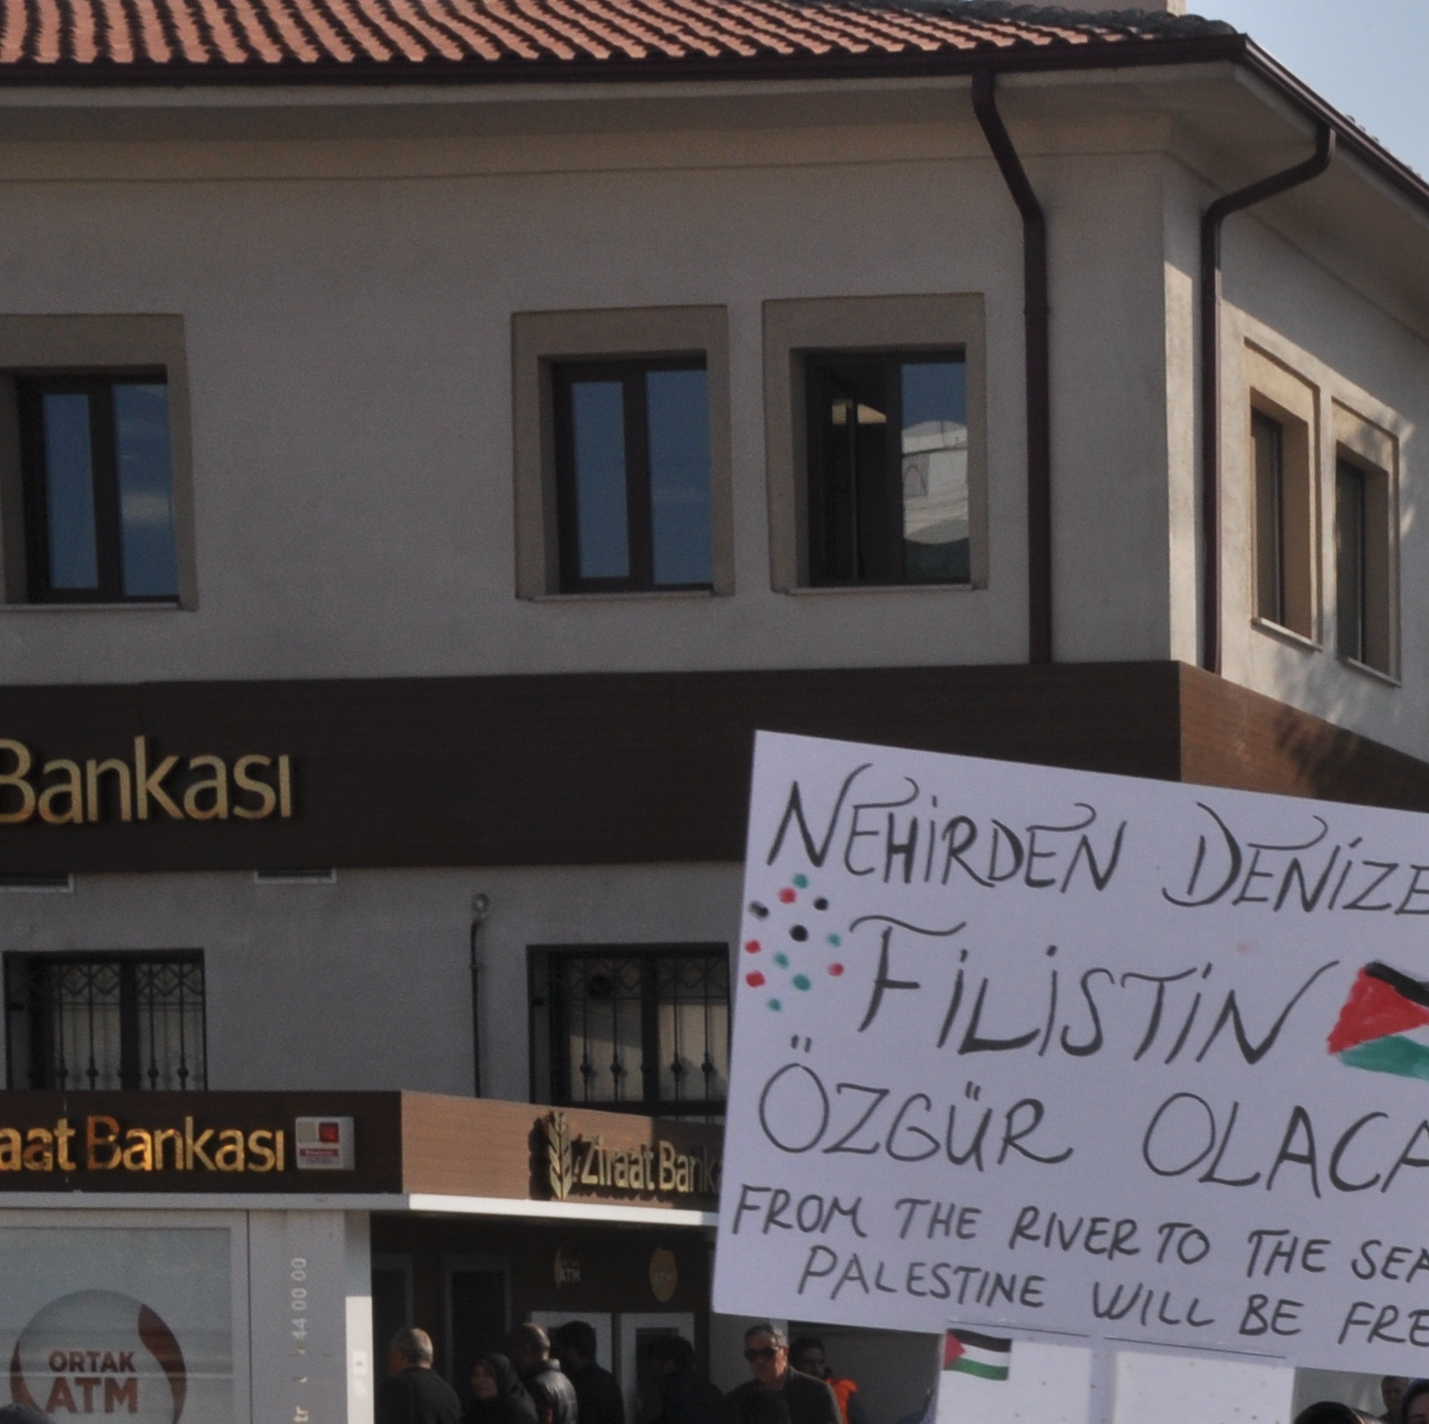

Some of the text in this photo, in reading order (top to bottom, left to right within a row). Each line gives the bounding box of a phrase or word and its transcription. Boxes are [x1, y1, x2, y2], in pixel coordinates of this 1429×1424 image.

[759, 1036, 1073, 1172] ÖZGÜR
[86, 1115, 285, 1172] Bankası
[581, 1134, 655, 1190] Ziraat
[731, 1184, 868, 1238] FROM
[895, 1197, 981, 1241] THE
[1009, 1206, 1141, 1261] RIVER
[1157, 1222, 1211, 1265] TO
[1246, 1229, 1327, 1278] THE
[798, 1244, 1047, 1309] PALESTINE
[1092, 1281, 1214, 1328] WILL
[1239, 1292, 1304, 1338] BE
[49, 1351, 135, 1374] ORTAK
[45, 1377, 138, 1414] ATM
